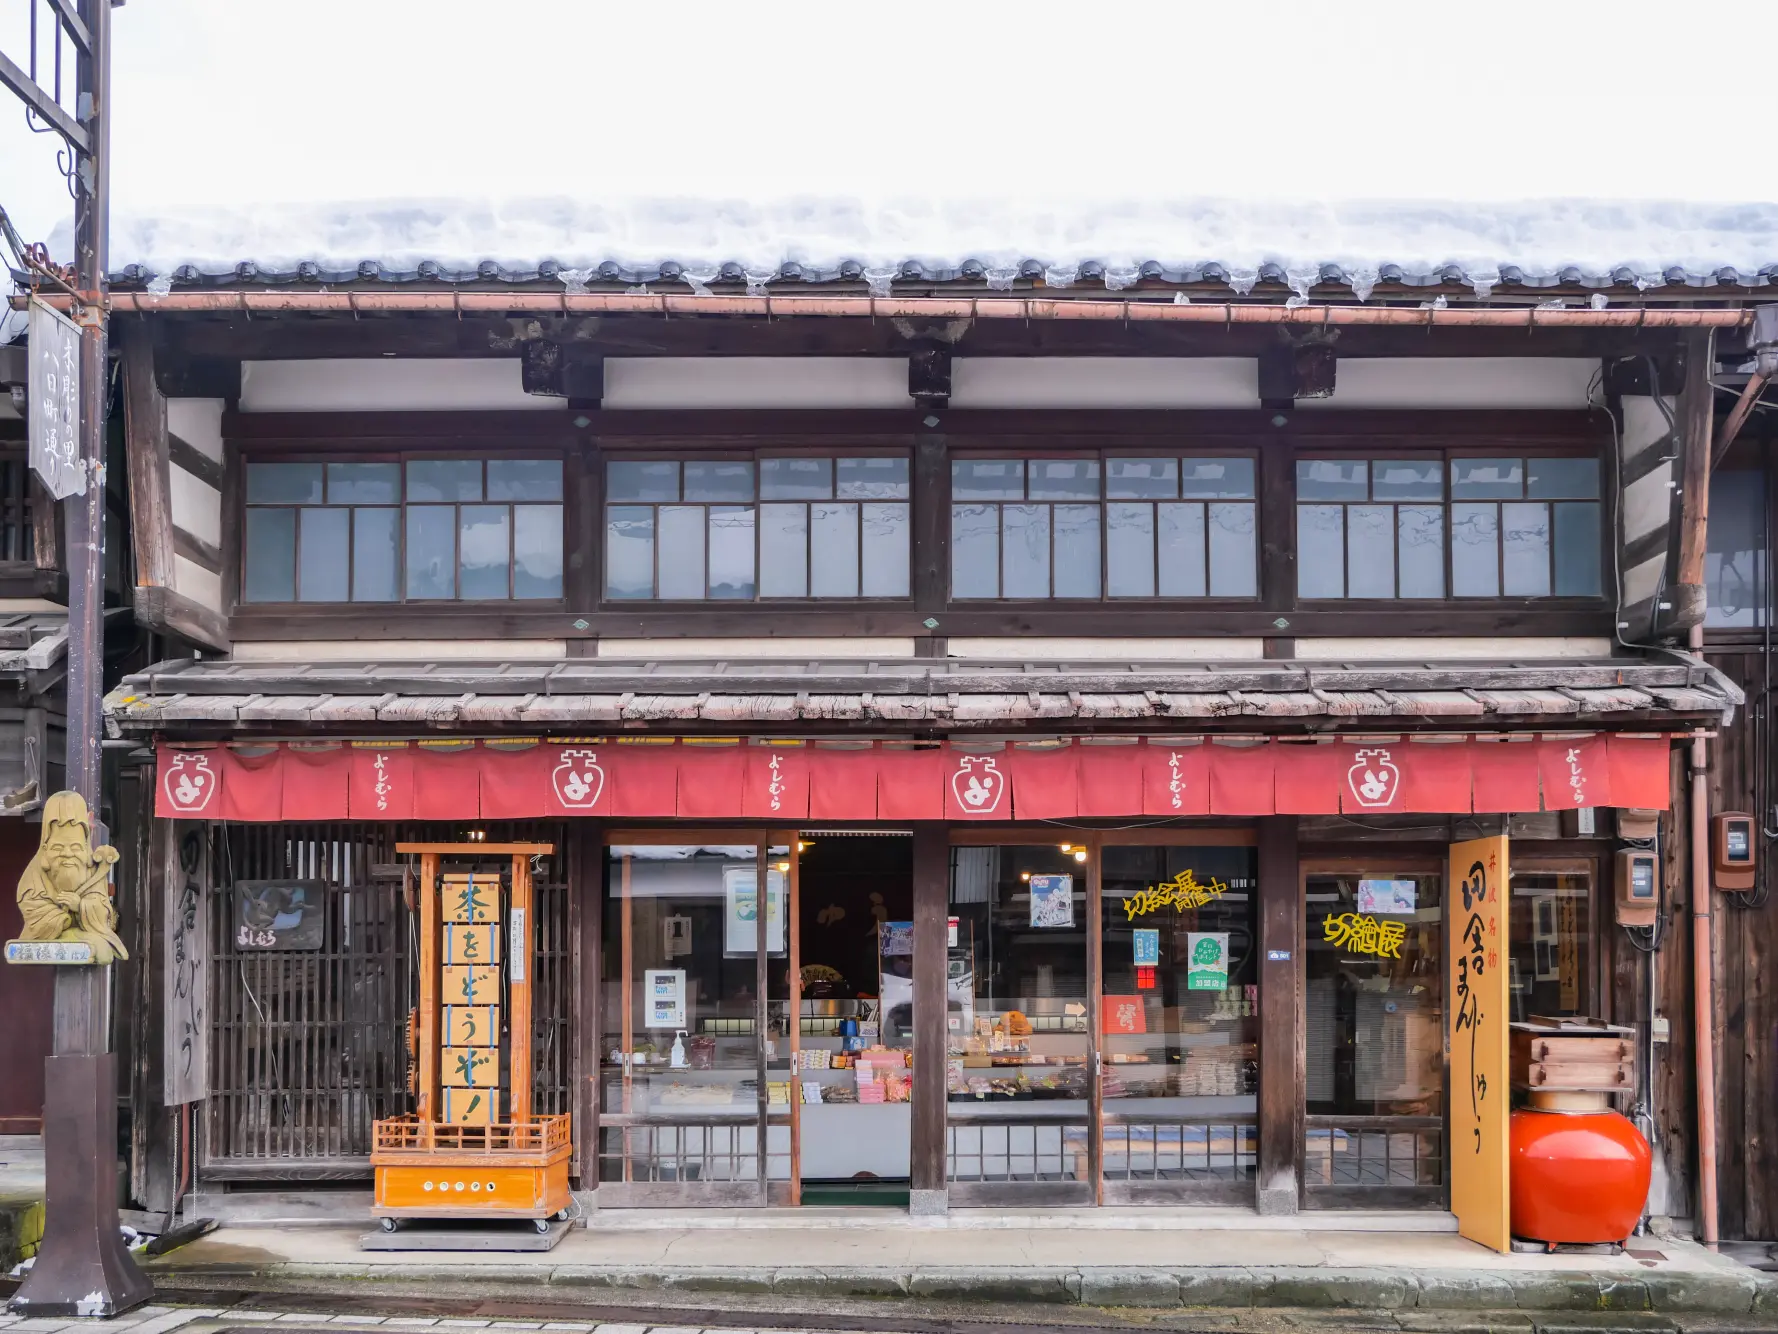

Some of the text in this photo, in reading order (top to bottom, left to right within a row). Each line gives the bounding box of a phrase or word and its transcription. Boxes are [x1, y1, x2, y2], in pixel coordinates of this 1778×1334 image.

[43, 351, 61, 476] 八日町通り
[373, 753, 392, 811] よしむら
[768, 754, 786, 811] よしむら
[1168, 752, 1187, 809] よしむら
[1565, 748, 1587, 803] よしむら
[237, 925, 277, 947] よしむら
[1487, 850, 1497, 969] 井波名物
